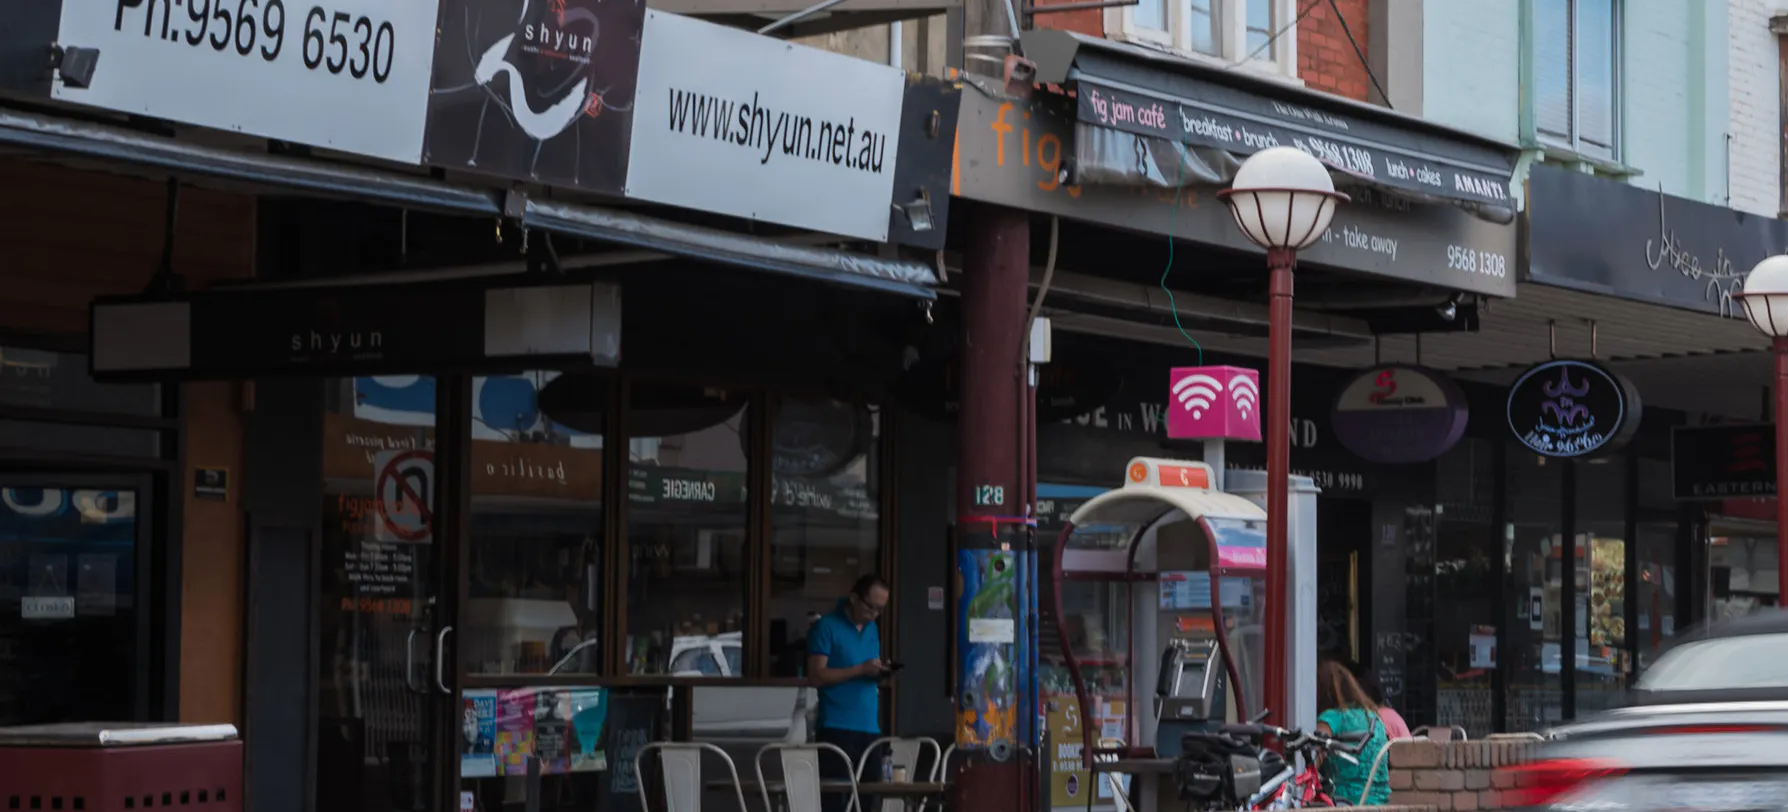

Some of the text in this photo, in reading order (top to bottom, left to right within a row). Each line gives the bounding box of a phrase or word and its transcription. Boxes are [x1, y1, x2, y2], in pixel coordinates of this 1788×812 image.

[302, 12, 395, 83] 6530
[525, 22, 592, 53] shyun
[1091, 90, 1167, 129] fig jam café
[668, 87, 886, 175] www.shyun.net.au
[1180, 106, 1233, 143] breakfast
[1386, 158, 1409, 180] lunch
[1416, 165, 1442, 187] cakes
[1344, 224, 1369, 250] take
[1371, 236, 1398, 261] away
[1447, 244, 1476, 273] 9568
[1479, 252, 1506, 279] 1308
[291, 329, 382, 354] shyun
[1117, 412, 1133, 431] IN
[975, 485, 1004, 505] 128
